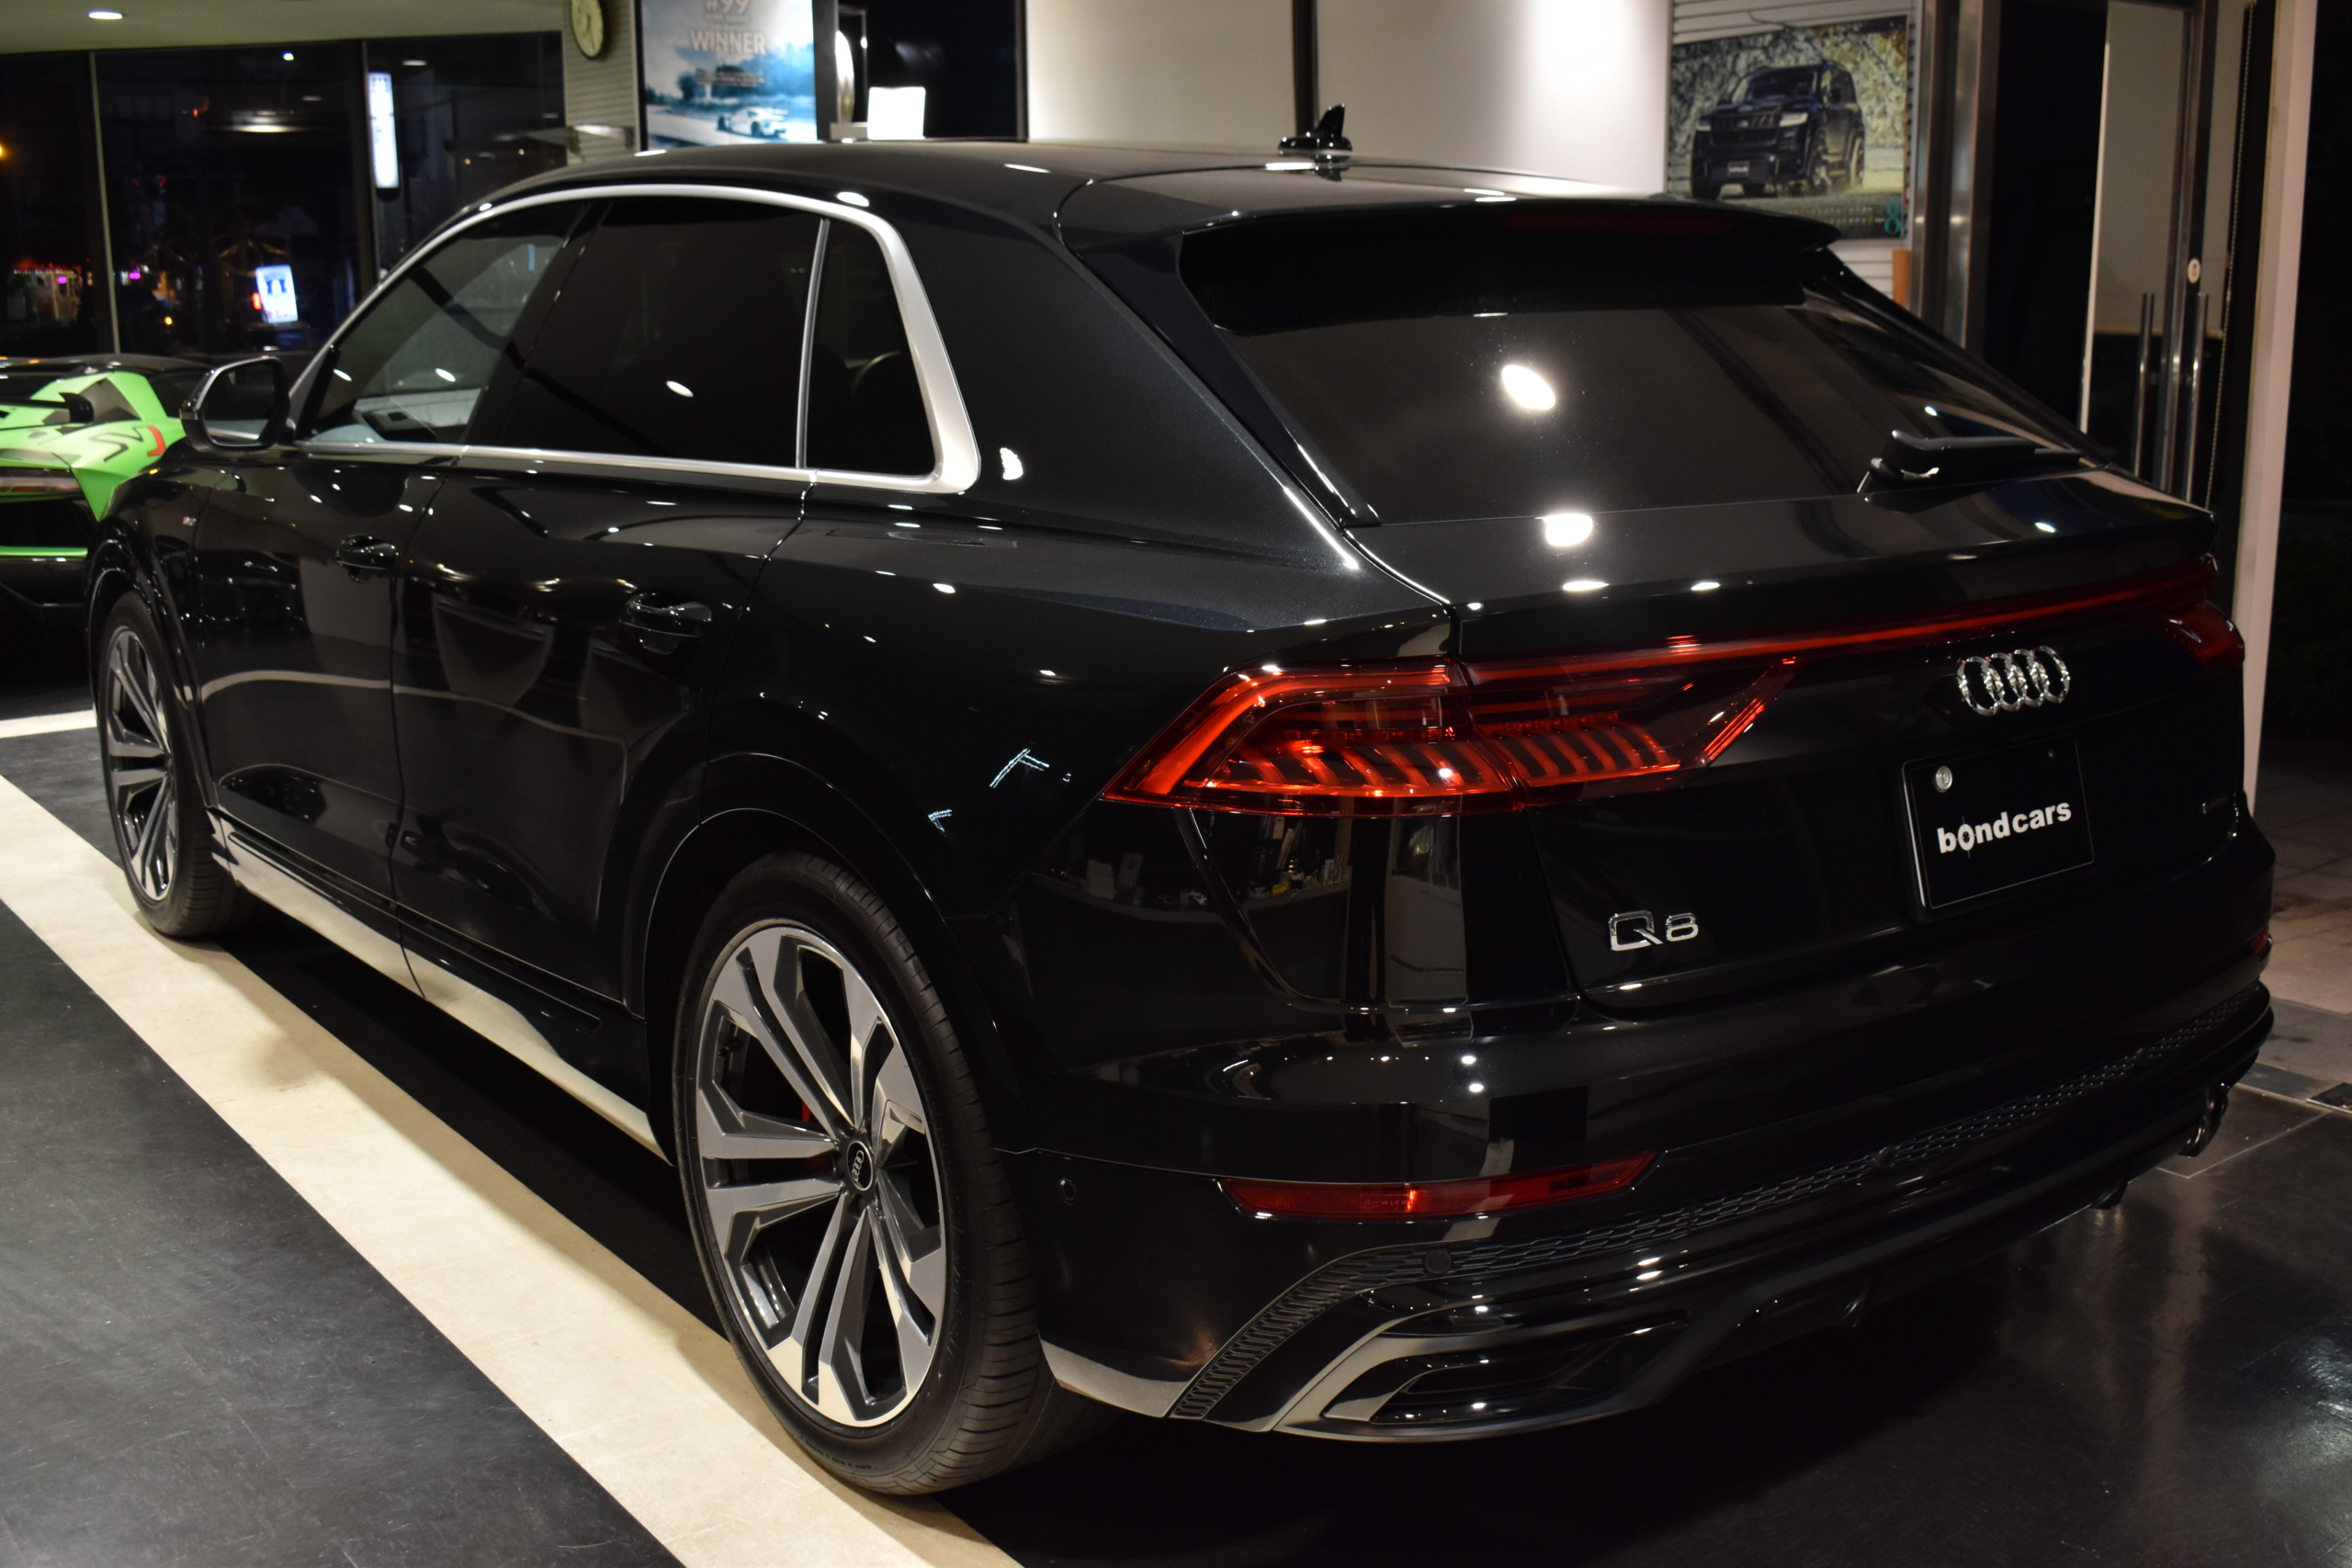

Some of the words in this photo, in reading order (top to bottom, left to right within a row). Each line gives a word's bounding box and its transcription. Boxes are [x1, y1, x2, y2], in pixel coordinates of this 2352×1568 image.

[690, 30, 766, 55] WINNER
[1884, 195, 1901, 235] 8
[1608, 909, 1699, 953] Q8
